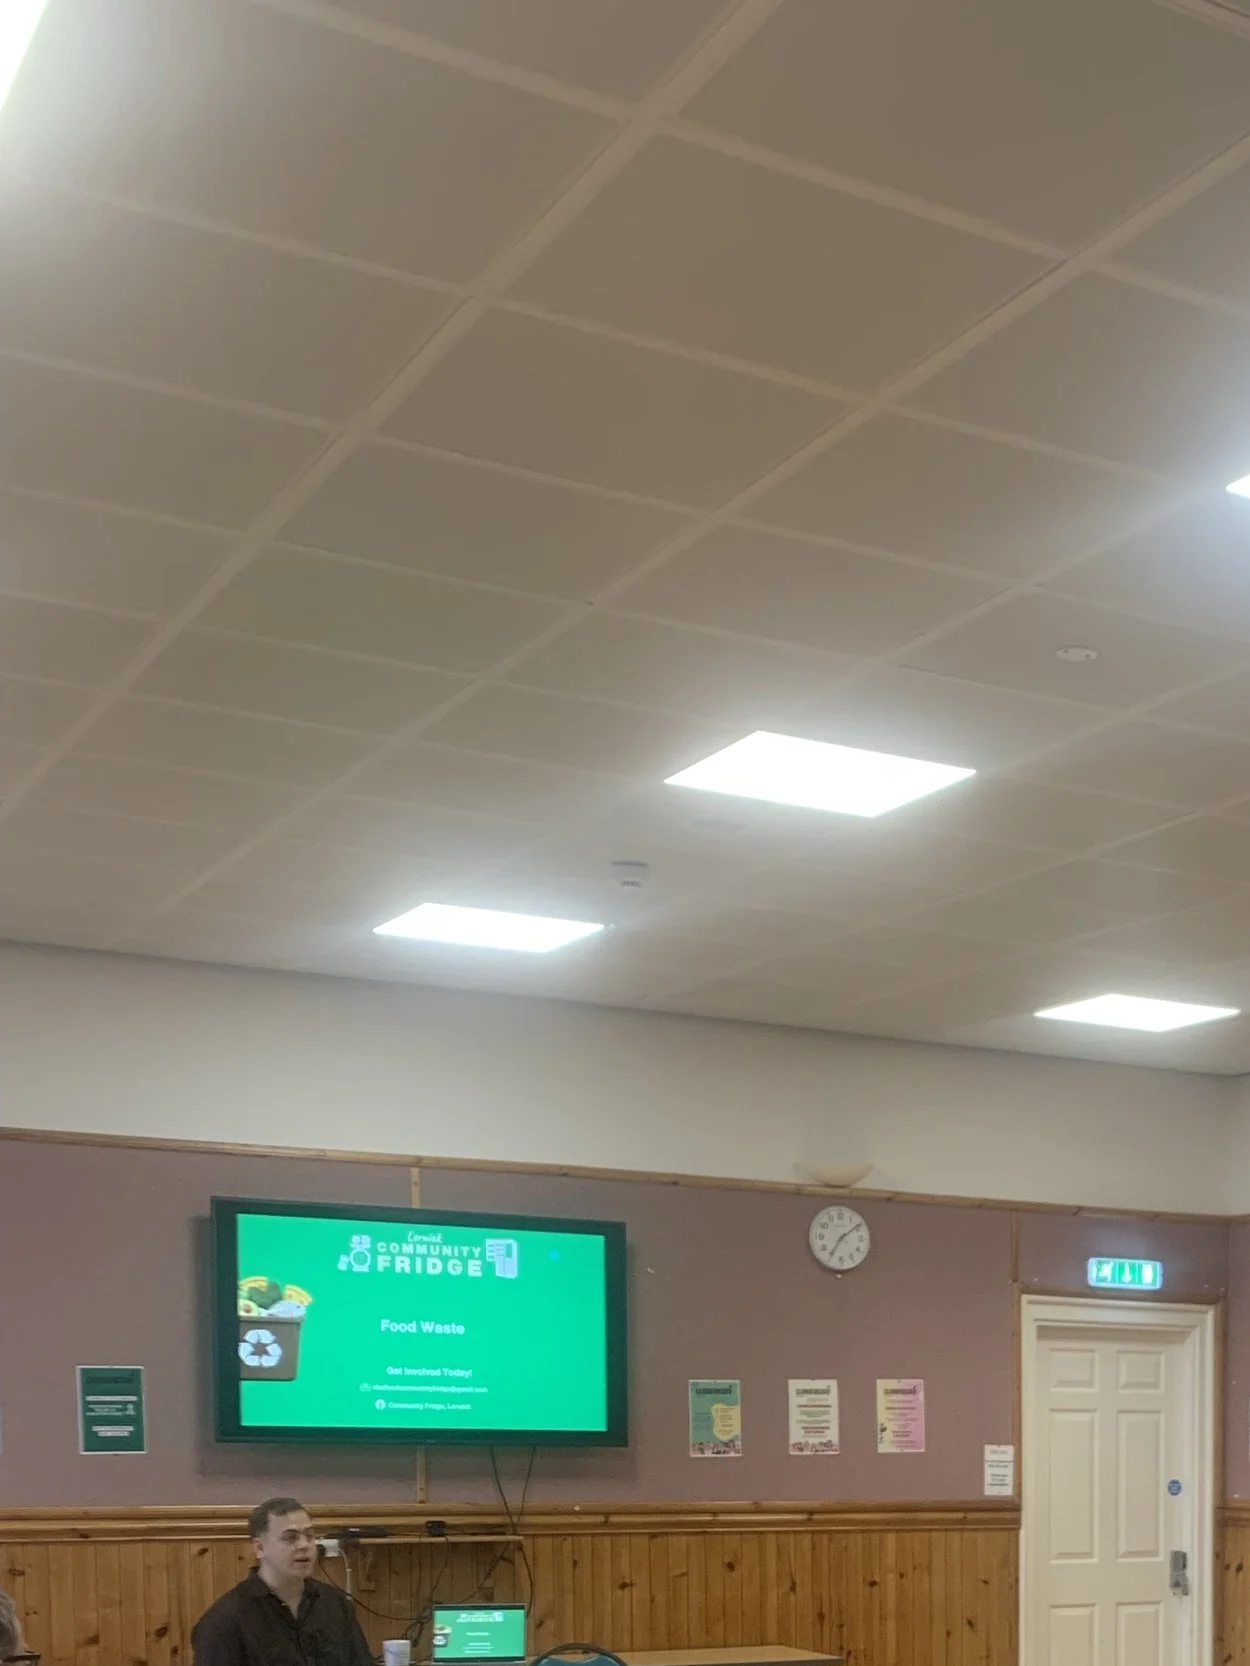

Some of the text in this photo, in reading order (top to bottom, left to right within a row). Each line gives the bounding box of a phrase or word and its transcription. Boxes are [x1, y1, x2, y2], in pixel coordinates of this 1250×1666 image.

[376, 1241, 482, 1258] COMMUNITY
[376, 1255, 483, 1277] FRIDGE
[380, 1319, 466, 1335] Food Waste
[386, 1366, 473, 1379] Get Involved Today!
